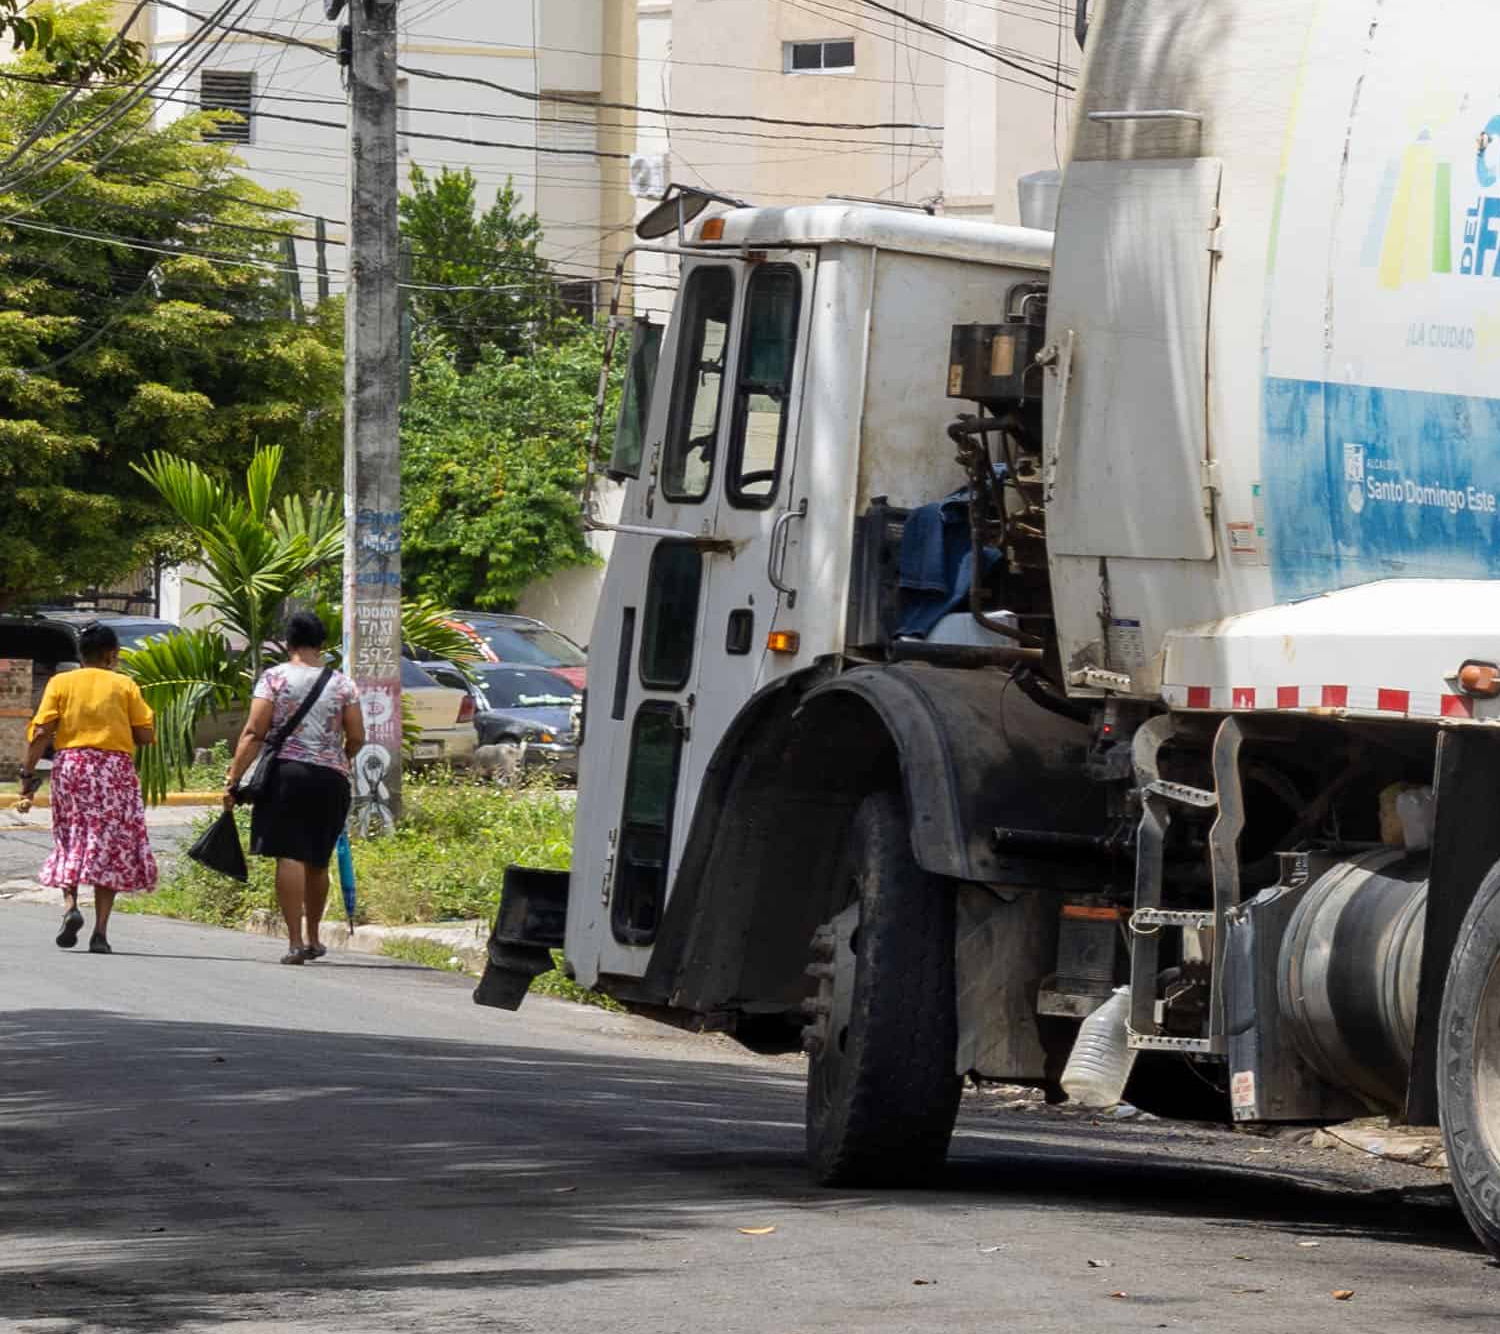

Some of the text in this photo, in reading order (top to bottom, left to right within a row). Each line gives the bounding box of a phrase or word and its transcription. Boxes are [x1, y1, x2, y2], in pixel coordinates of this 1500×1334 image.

[1460, 196, 1481, 275] DEL
[1367, 475, 1404, 502] Santo
[1405, 479, 1465, 514] Domingo
[1466, 486, 1497, 514] Este
[359, 619, 393, 635] TAXI
